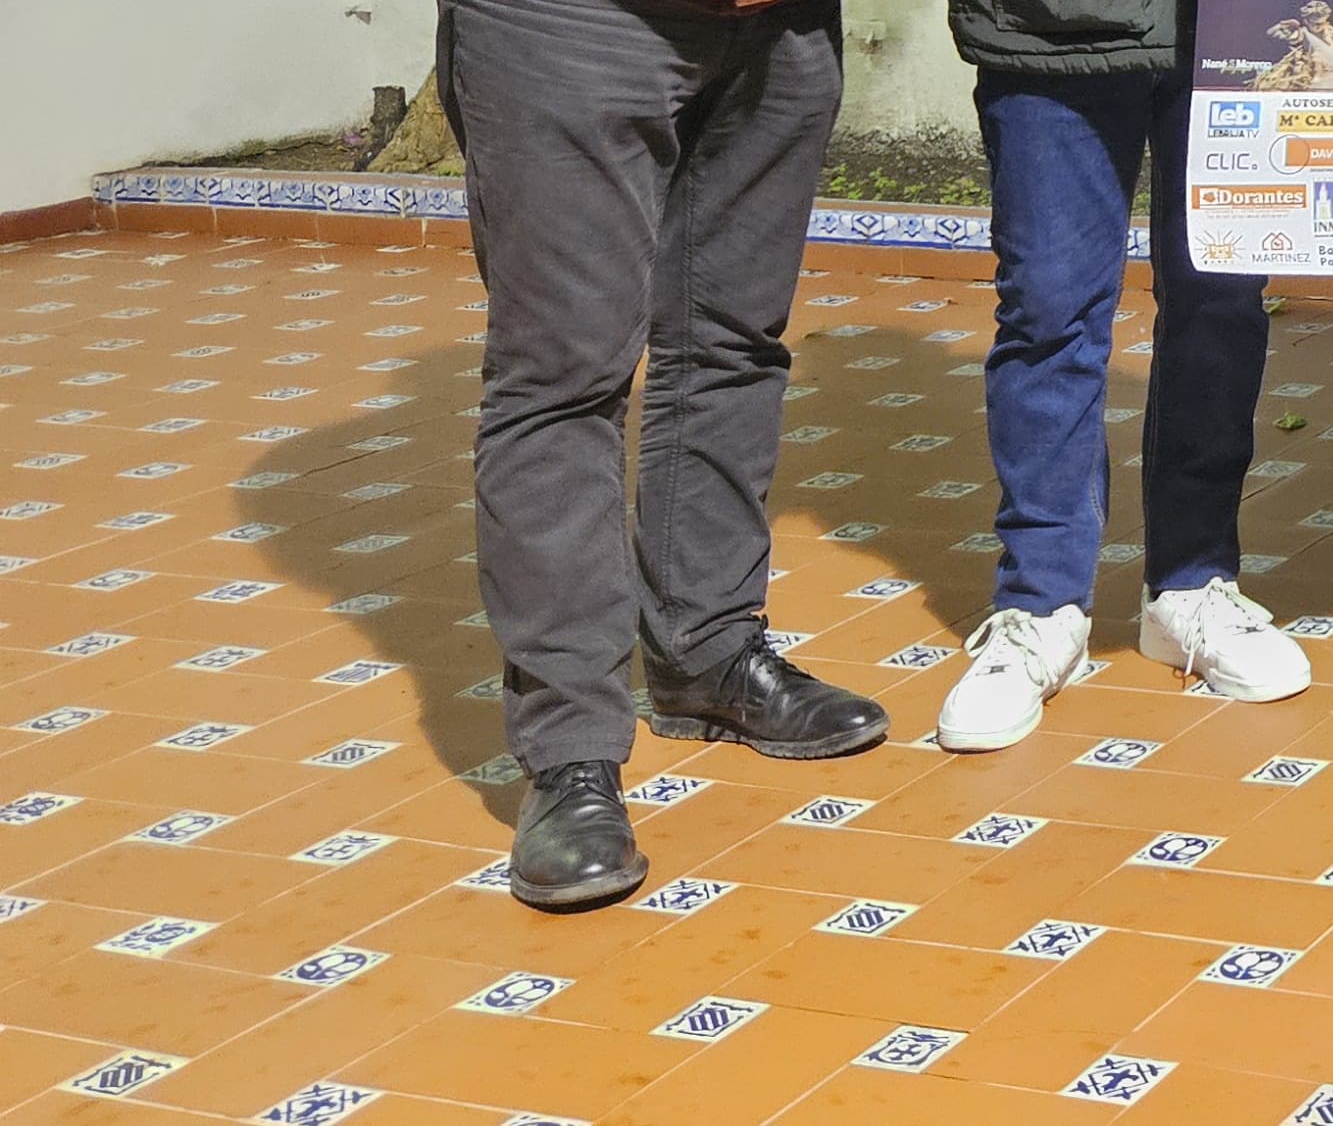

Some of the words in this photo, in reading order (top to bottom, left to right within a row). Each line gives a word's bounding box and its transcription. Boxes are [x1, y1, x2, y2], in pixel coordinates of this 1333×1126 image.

[1211, 102, 1255, 126] leb
[1245, 130, 1260, 138] TV
[1218, 189, 1304, 204] Dorantes
[1252, 253, 1311, 263] MARTINEZ
